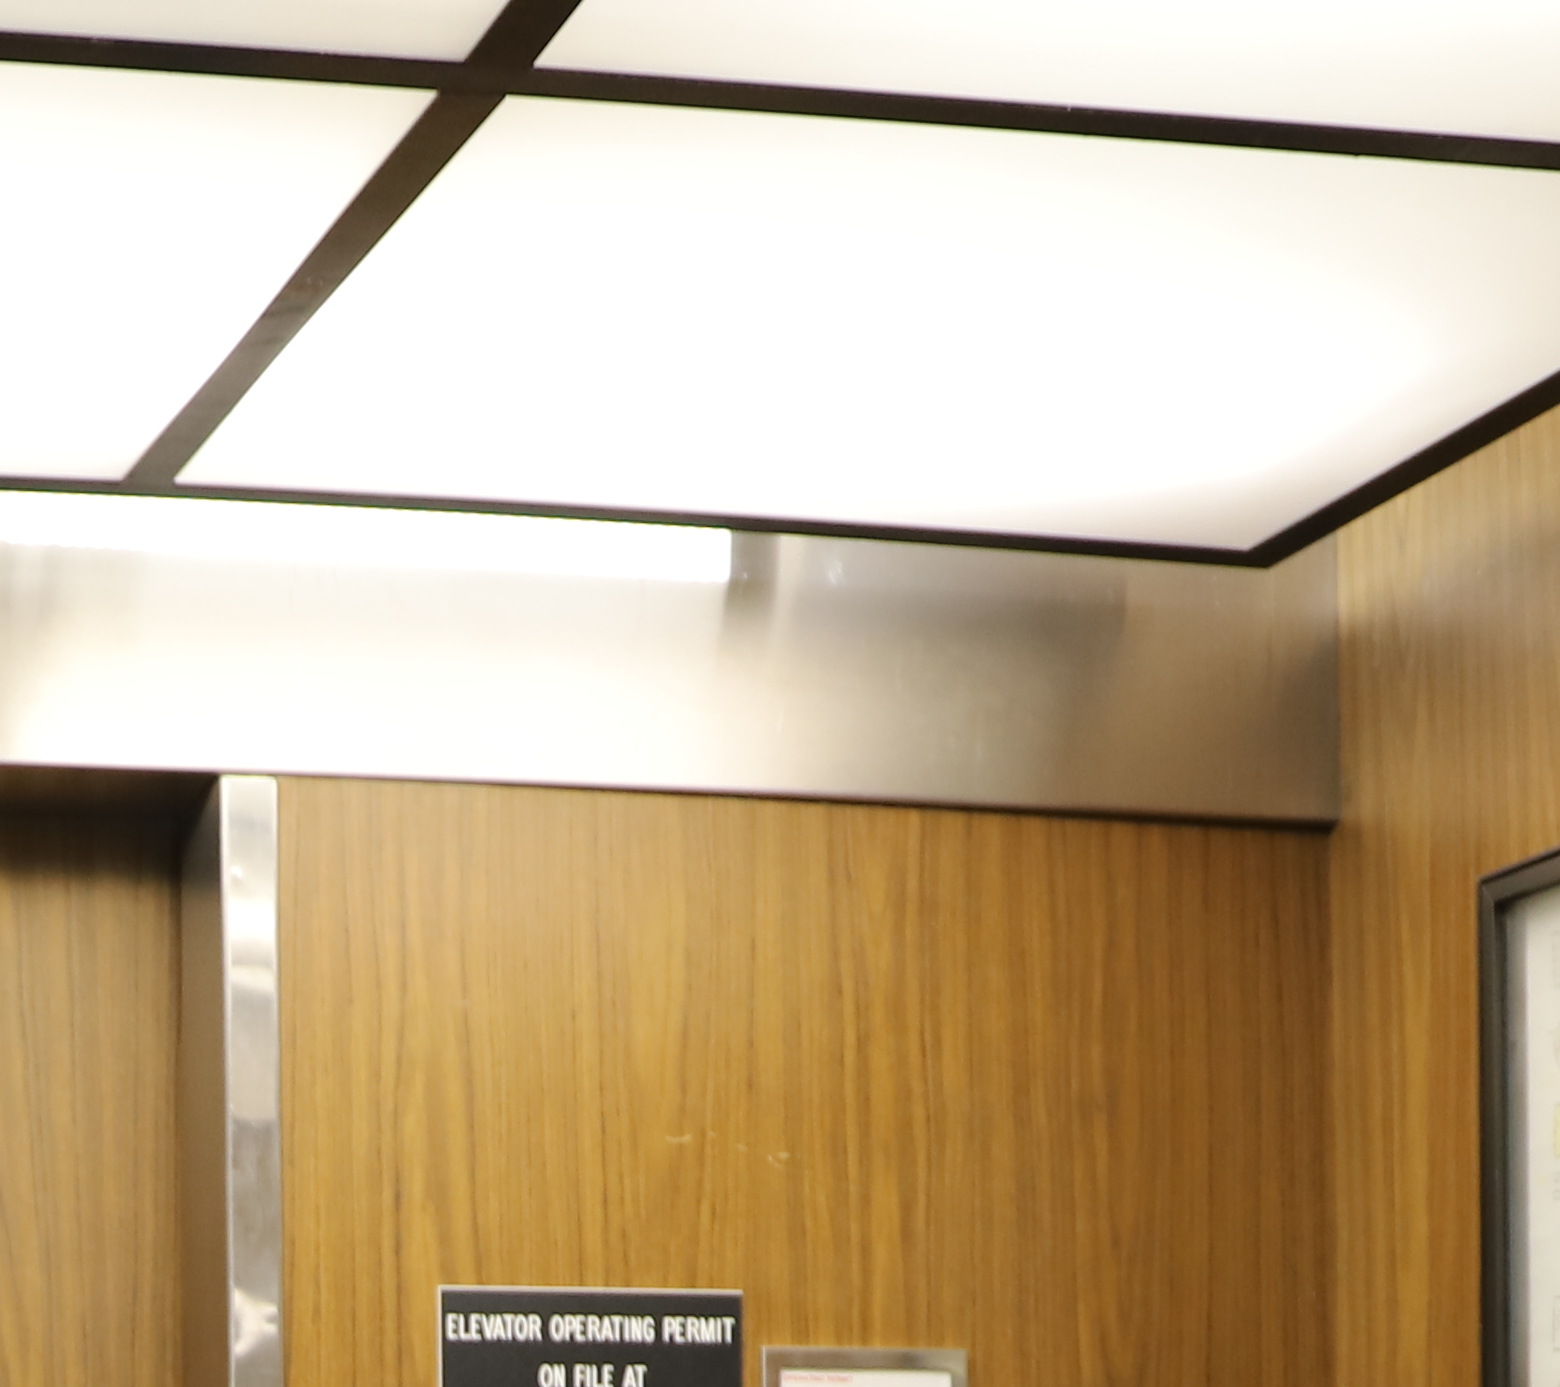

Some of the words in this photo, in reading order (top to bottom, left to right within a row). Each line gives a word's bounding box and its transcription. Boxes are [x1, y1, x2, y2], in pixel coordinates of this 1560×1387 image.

[445, 1313, 543, 1342] ELEVATOR
[548, 1314, 656, 1343] OPERATING
[661, 1316, 736, 1344] PERMIT
